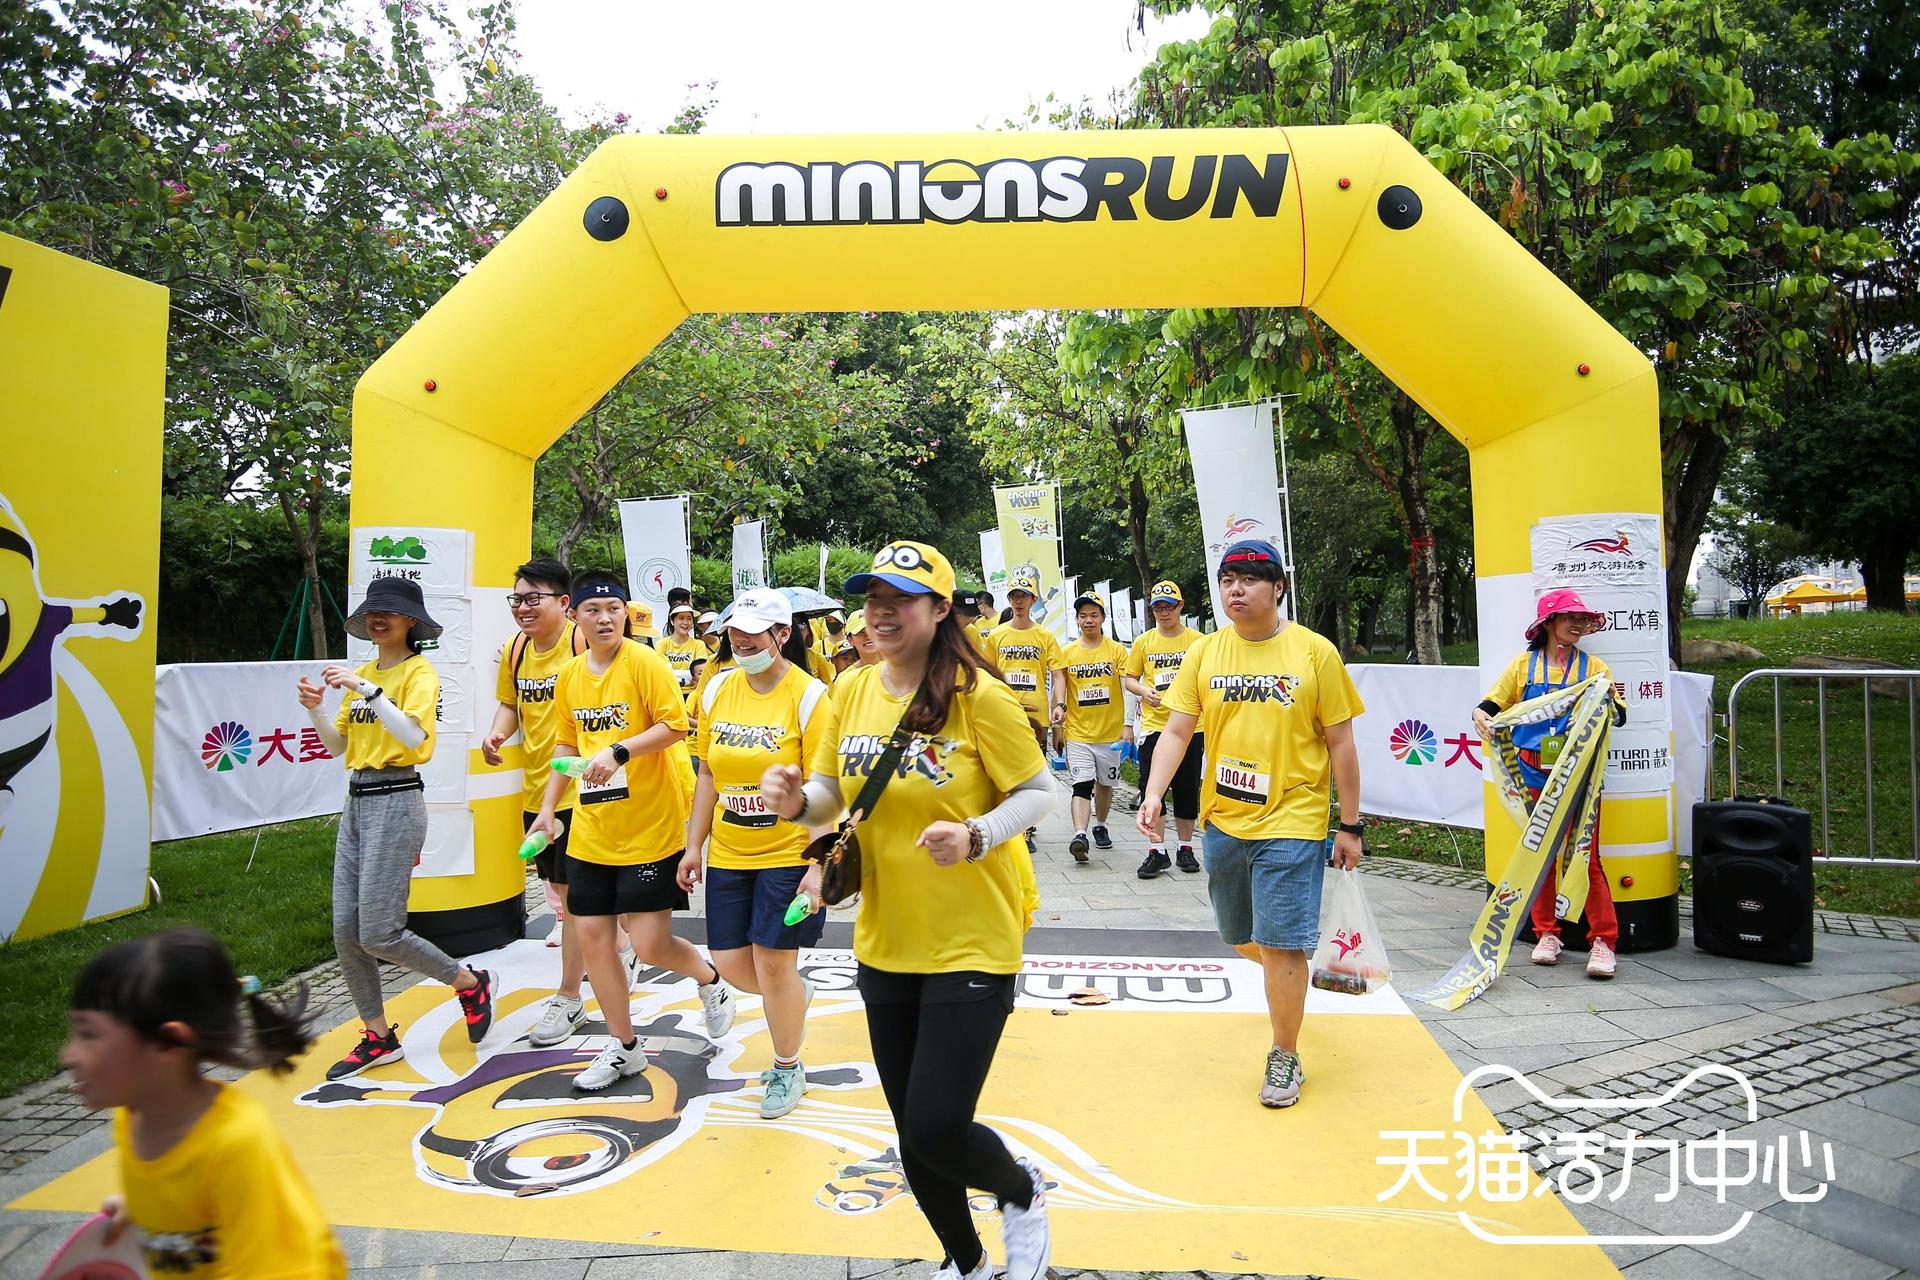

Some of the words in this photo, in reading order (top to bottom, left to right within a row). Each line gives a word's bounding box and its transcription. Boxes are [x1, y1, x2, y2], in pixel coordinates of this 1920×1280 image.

[1599, 609, 1660, 632] 汇体育
[1076, 668, 1108, 679] RUN
[522, 686, 554, 703] RUN
[1223, 687, 1268, 702] RUN
[1639, 681, 1664, 699] 体育
[716, 732, 760, 748] RUN
[1443, 732, 1483, 771] 大
[1607, 749, 1650, 760] TURN
[1621, 760, 1650, 771] MAN
[1220, 767, 1256, 791] 10044
[727, 796, 766, 813] 10949
[804, 954, 859, 962] 021
